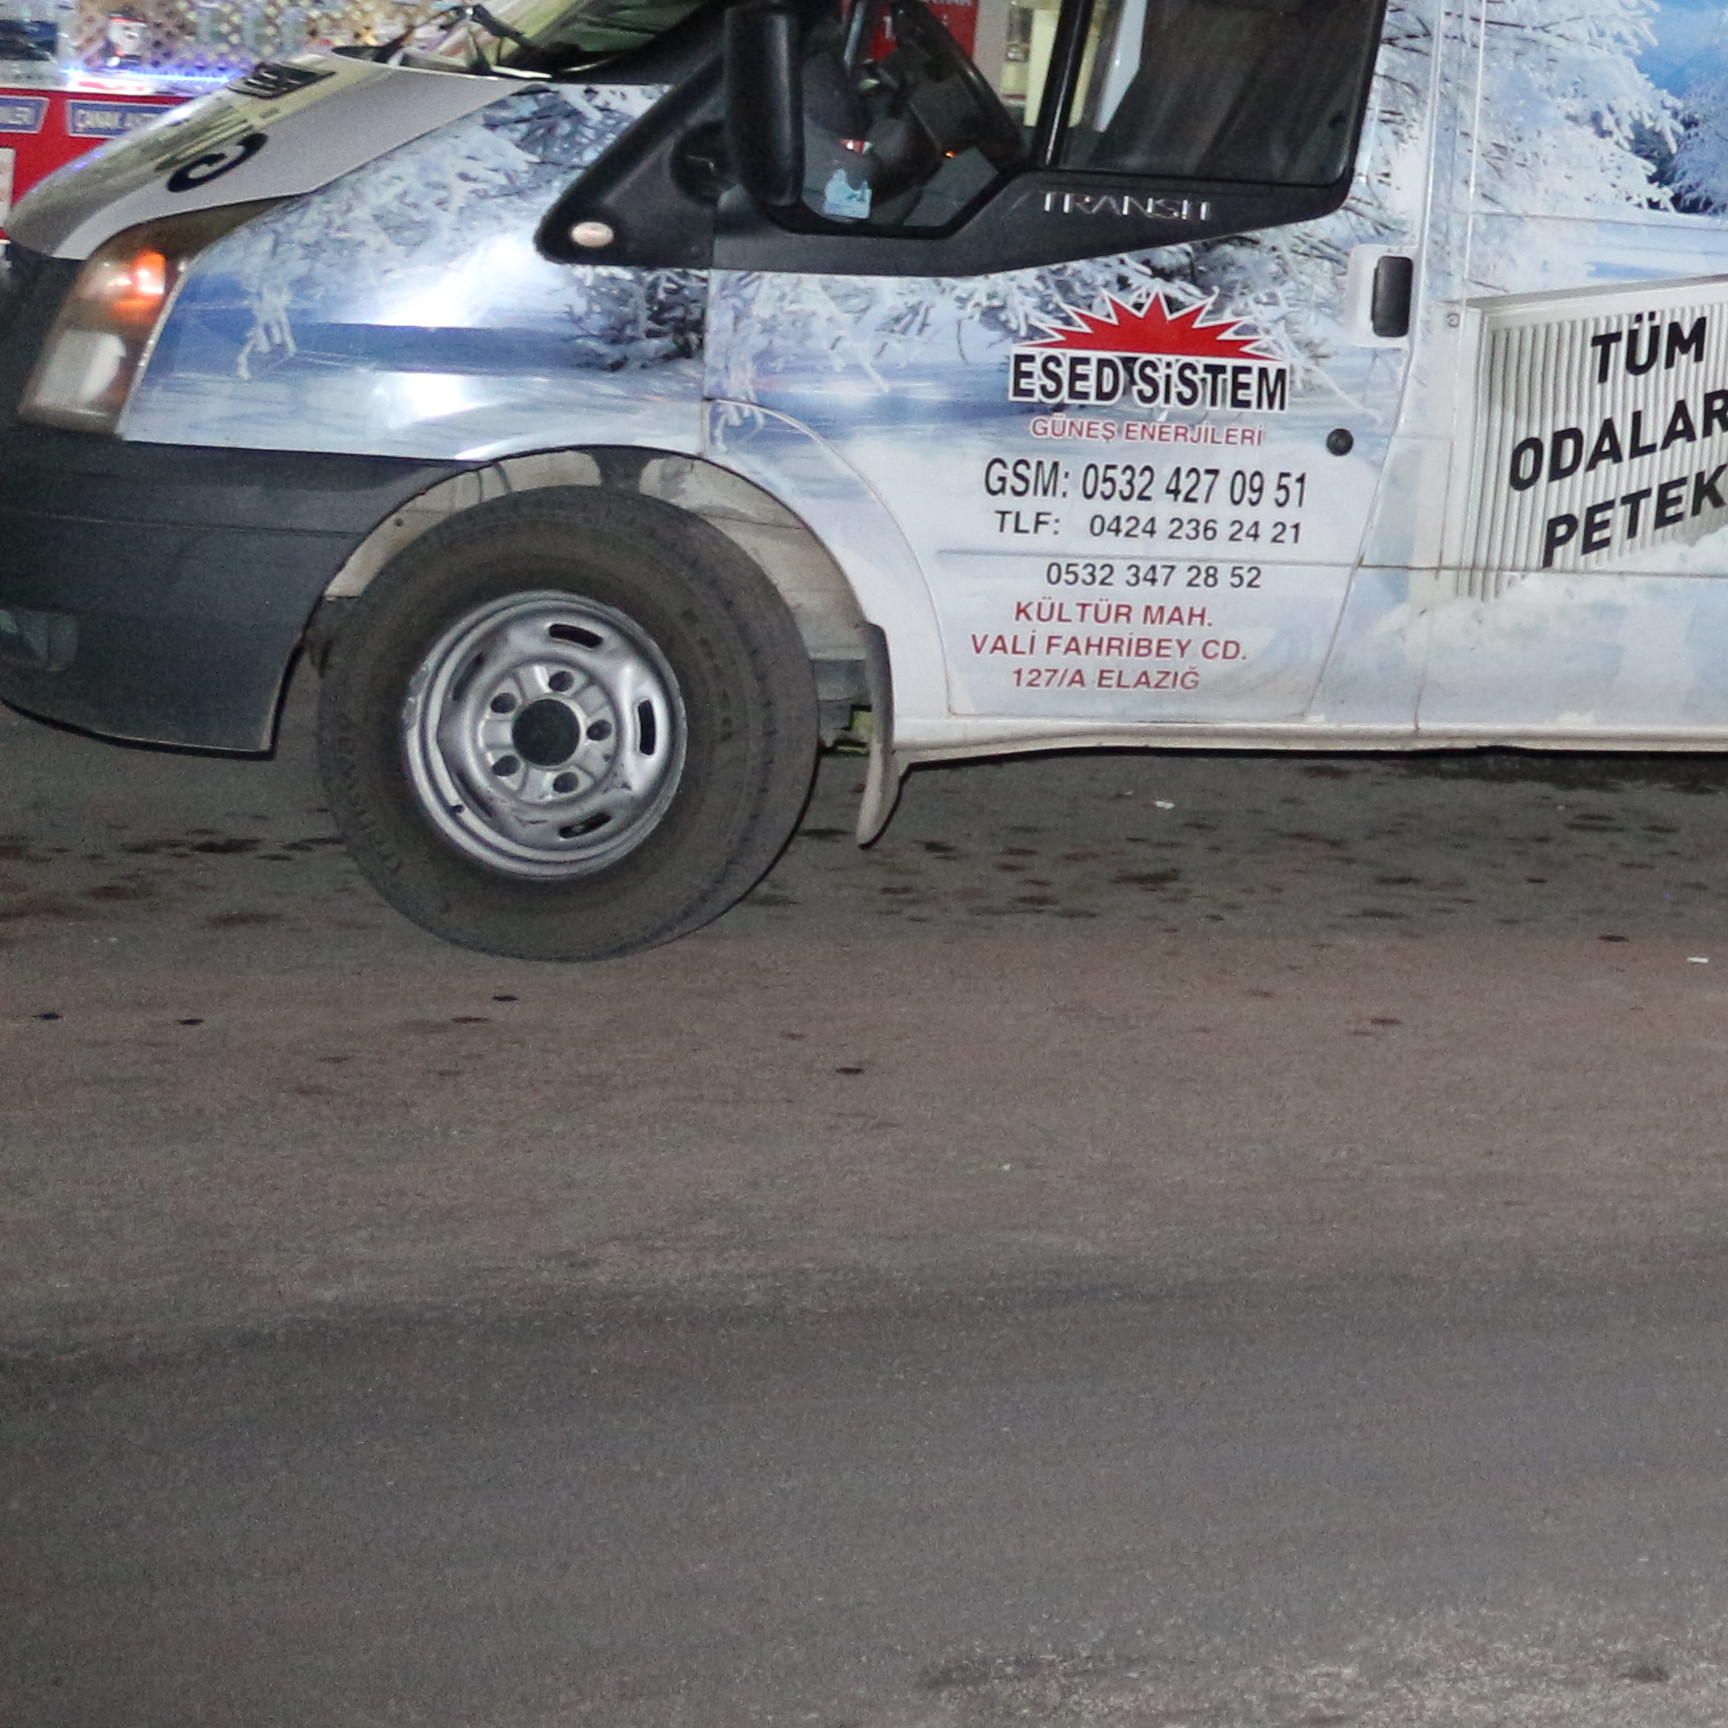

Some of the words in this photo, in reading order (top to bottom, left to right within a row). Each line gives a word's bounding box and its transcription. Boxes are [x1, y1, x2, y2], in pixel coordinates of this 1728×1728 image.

[1590, 311, 1709, 385] TÜM
[1009, 351, 1124, 404] ESED
[1030, 413, 1117, 443] GÜNEŞ
[1124, 419, 1266, 448] ENERJİLERİ
[984, 457, 1070, 499] GSM:
[1081, 462, 1156, 503] 0532
[1165, 467, 1220, 505] 427
[1229, 470, 1265, 506] 09
[1274, 470, 1308, 509] 51
[994, 509, 1060, 536] TLF:
[1088, 513, 1157, 540] 0424
[1168, 515, 1218, 542] 236
[1228, 518, 1261, 543] 24
[1270, 519, 1302, 545] 21
[1541, 463, 1728, 569] PETEK
[1045, 561, 1115, 589] 0532
[1125, 563, 1176, 589] 347
[1185, 564, 1219, 590] 28
[1229, 564, 1263, 590] 52
[1014, 595, 1134, 626] KÜLTÜR
[1142, 605, 1213, 628] MAH.
[971, 628, 1037, 656] VALİ
[1045, 630, 1193, 660] FAHRİBEY
[1201, 637, 1248, 661] CD.
[1011, 667, 1086, 689] 127/A
[1096, 663, 1200, 691] ELAZIĞ
